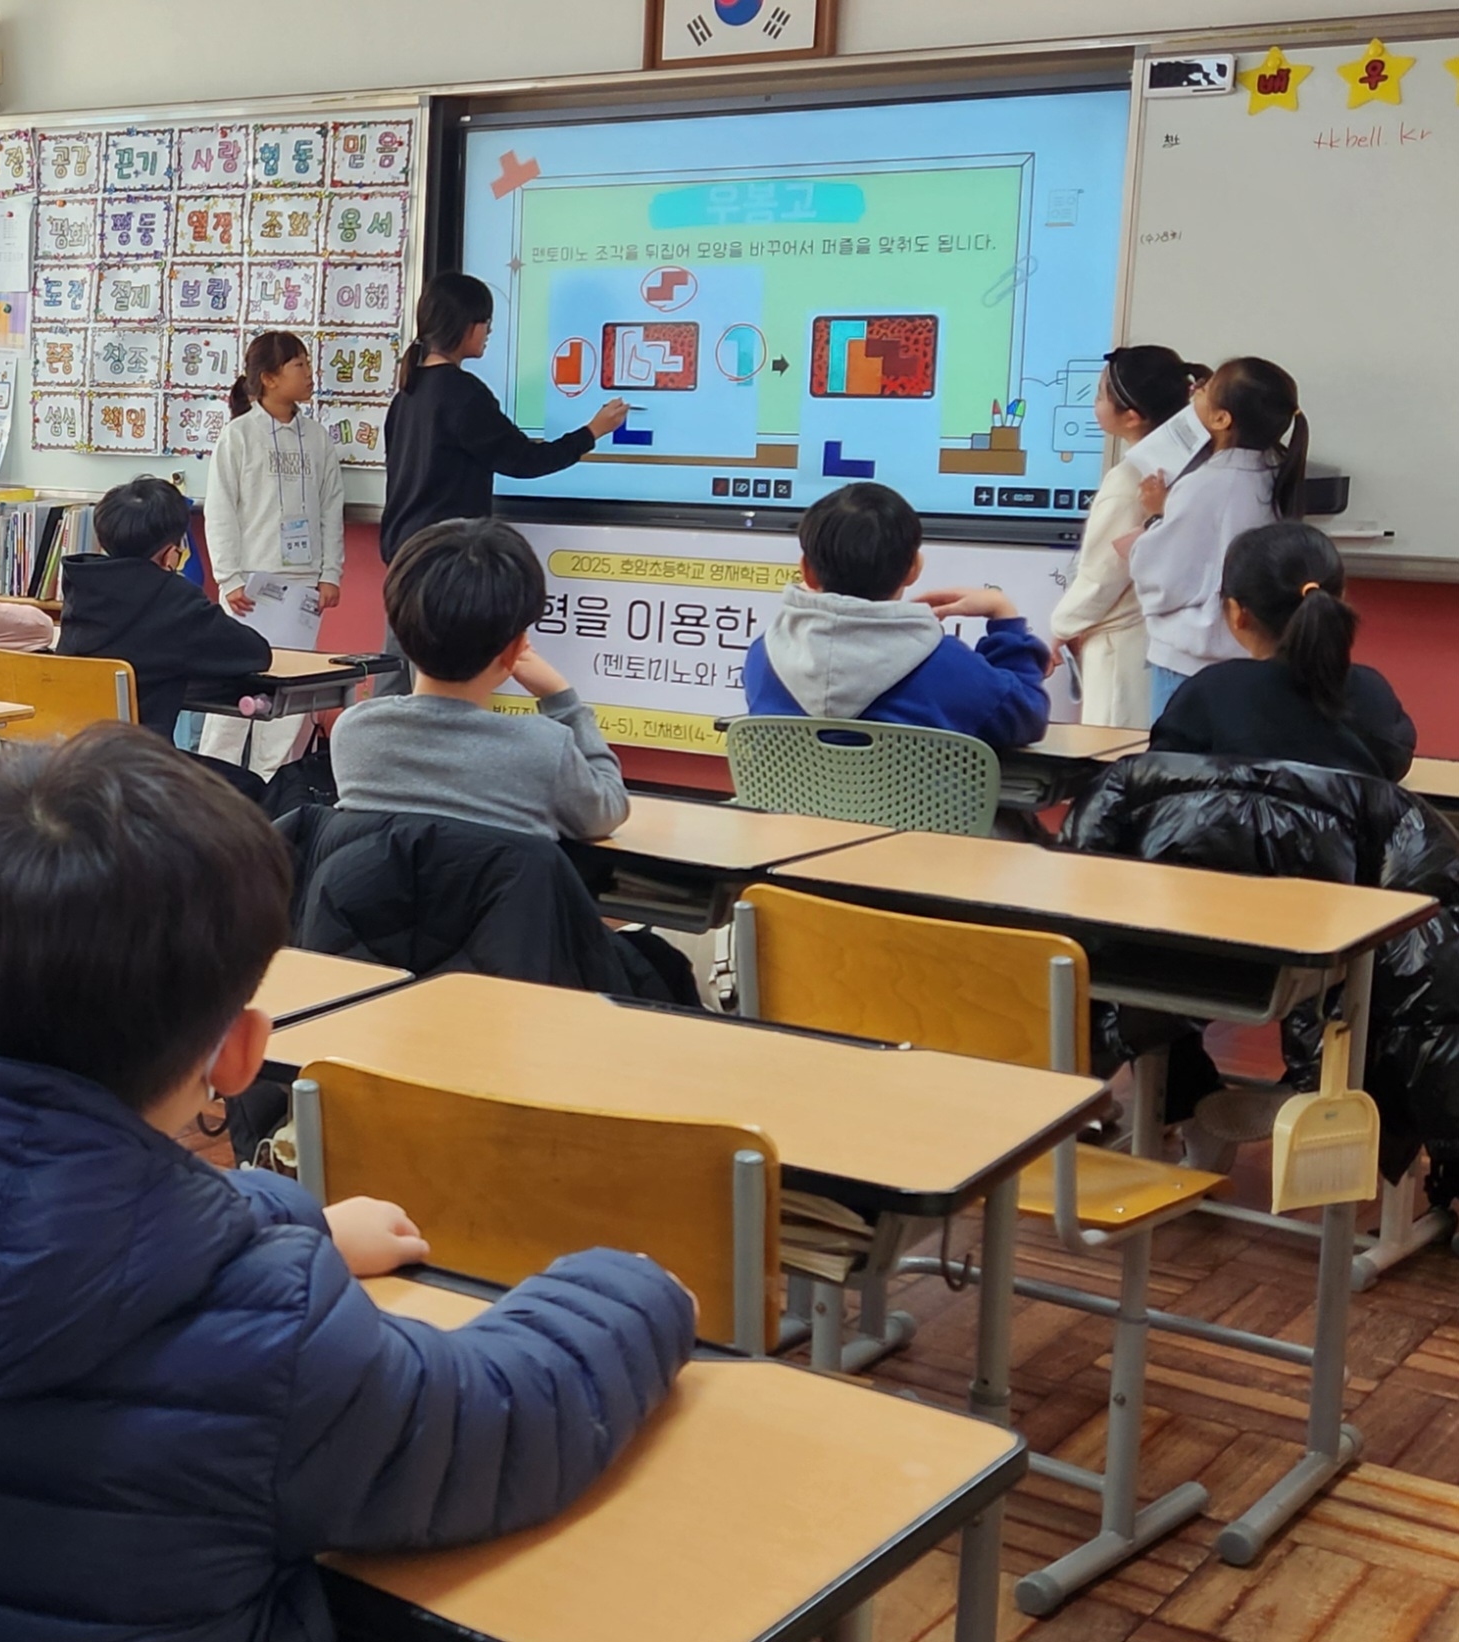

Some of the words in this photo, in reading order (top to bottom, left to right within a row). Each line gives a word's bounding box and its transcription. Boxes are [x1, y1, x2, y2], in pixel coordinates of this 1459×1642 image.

[1256, 67, 1291, 94] 배
[1358, 59, 1388, 91] 우
[51, 145, 91, 178] 공감
[114, 148, 158, 179] 끈기
[192, 140, 240, 173] 사랑
[259, 139, 314, 176] 협동
[343, 131, 399, 169] 믿음
[49, 217, 90, 249] 평화
[111, 211, 156, 246] 평등
[187, 210, 233, 244] 열정
[260, 210, 311, 239] 조화
[338, 207, 393, 242] 용서
[595, 243, 639, 262] 조각을
[645, 242, 690, 260] 뒤집어
[697, 241, 743, 259] 모양을
[749, 239, 814, 257] 바꾸어서
[821, 237, 871, 256] 퍼즐을
[878, 235, 930, 254] 맞춰도
[937, 233, 997, 253] 됩니다.
[43, 280, 85, 310] 도전
[111, 280, 151, 311] 절제
[180, 278, 232, 310] 보람
[337, 283, 389, 309] 이해
[46, 342, 74, 375] 존중
[102, 342, 149, 375] 창조
[182, 343, 228, 376] 용기
[330, 349, 382, 383] 실천
[44, 405, 76, 438] 성실
[101, 405, 146, 439] 책임
[571, 555, 615, 575] 2025.
[620, 558, 705, 581] 호암초등학교
[710, 563, 770, 584] 영재학급
[627, 598, 758, 650] 이용한
